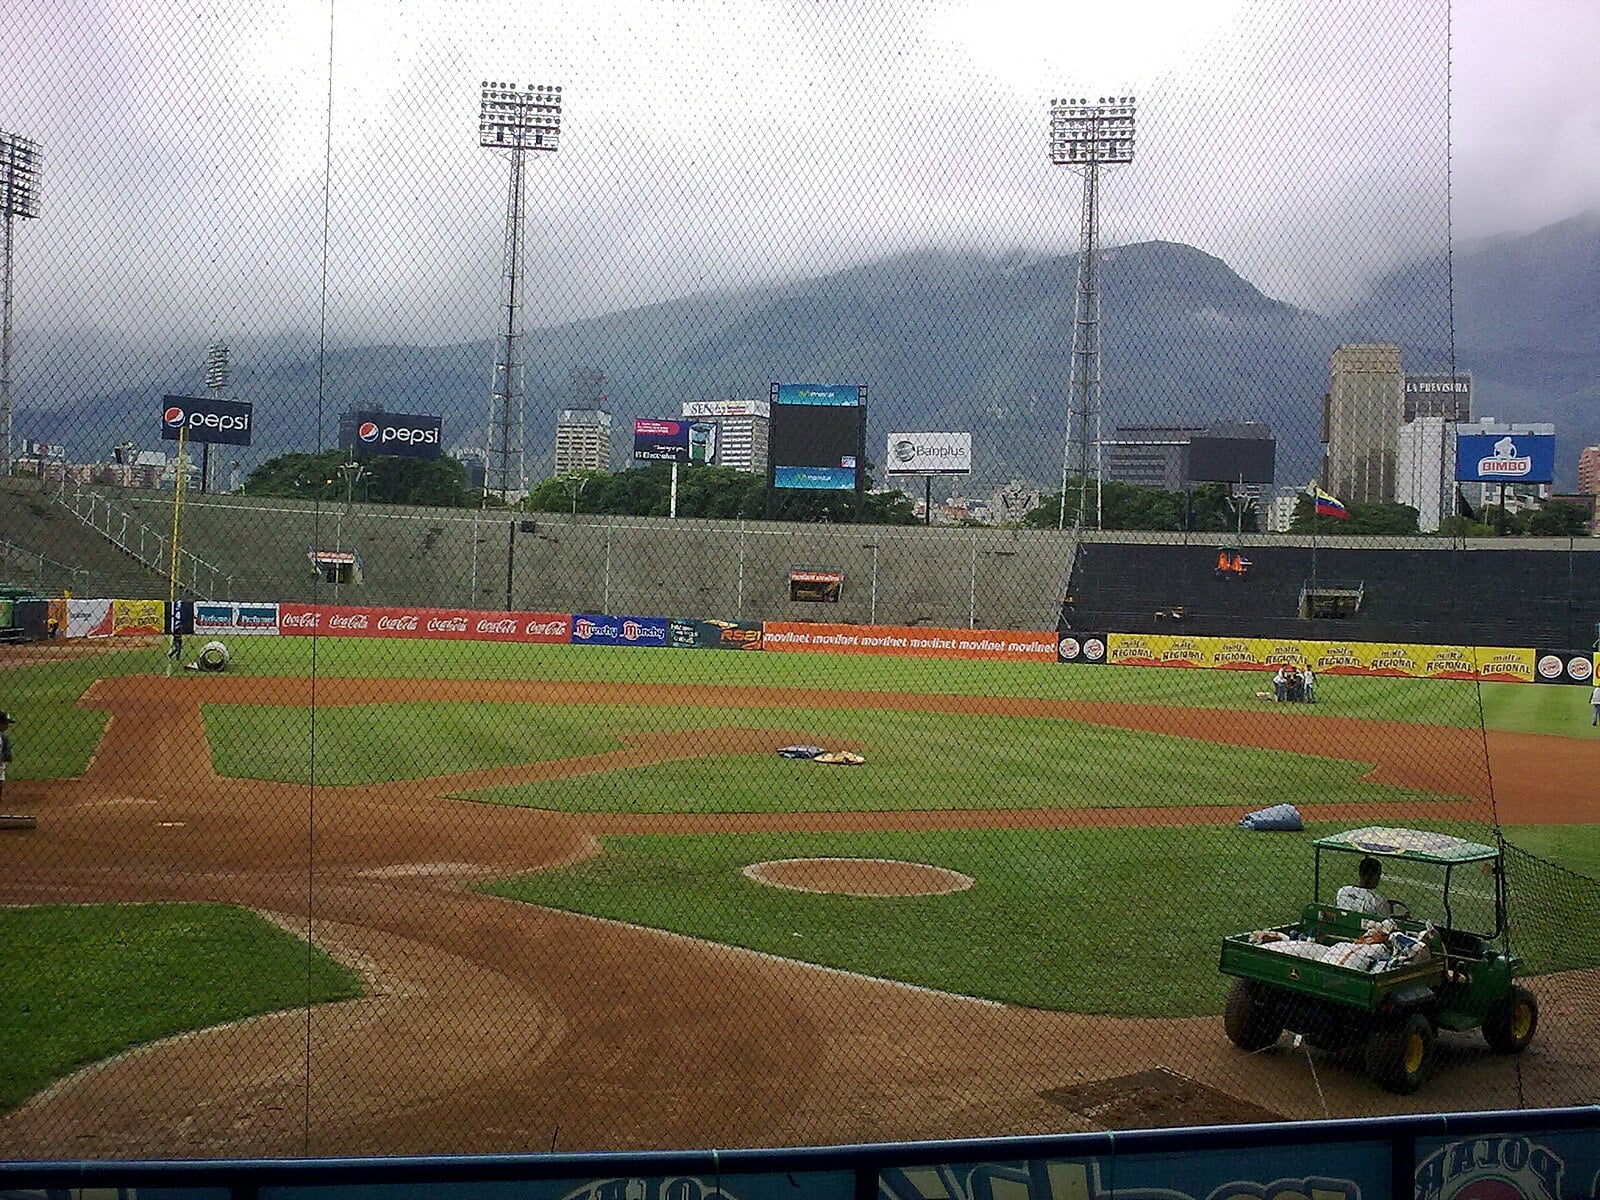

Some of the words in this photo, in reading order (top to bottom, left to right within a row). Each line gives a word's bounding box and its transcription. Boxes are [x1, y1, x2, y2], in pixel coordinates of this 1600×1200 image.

[1407, 383, 1417, 392] LA
[189, 413, 249, 432] pepsi
[382, 426, 439, 445] pepsi
[916, 445, 965, 457] Banplus
[1482, 461, 1527, 471] BIMBO
[763, 632, 809, 643] movilnet
[813, 634, 858, 645] movilnet
[861, 636, 907, 647] movilnet
[910, 637, 957, 649] movilnet
[959, 639, 1005, 651] movilnet
[1008, 640, 1056, 653] movilnet
[1112, 649, 1153, 658] REGIONAL
[1163, 651, 1204, 660] REGIONAL
[1214, 652, 1255, 662] REGIONAL
[1494, 653, 1521, 661] malta
[1265, 655, 1308, 665] REGIONAL
[1318, 656, 1361, 666] REGIONAL
[1371, 658, 1416, 669] REGIONAL
[1426, 661, 1472, 672] REGIONAL
[1482, 663, 1530, 674] REGIONAL
